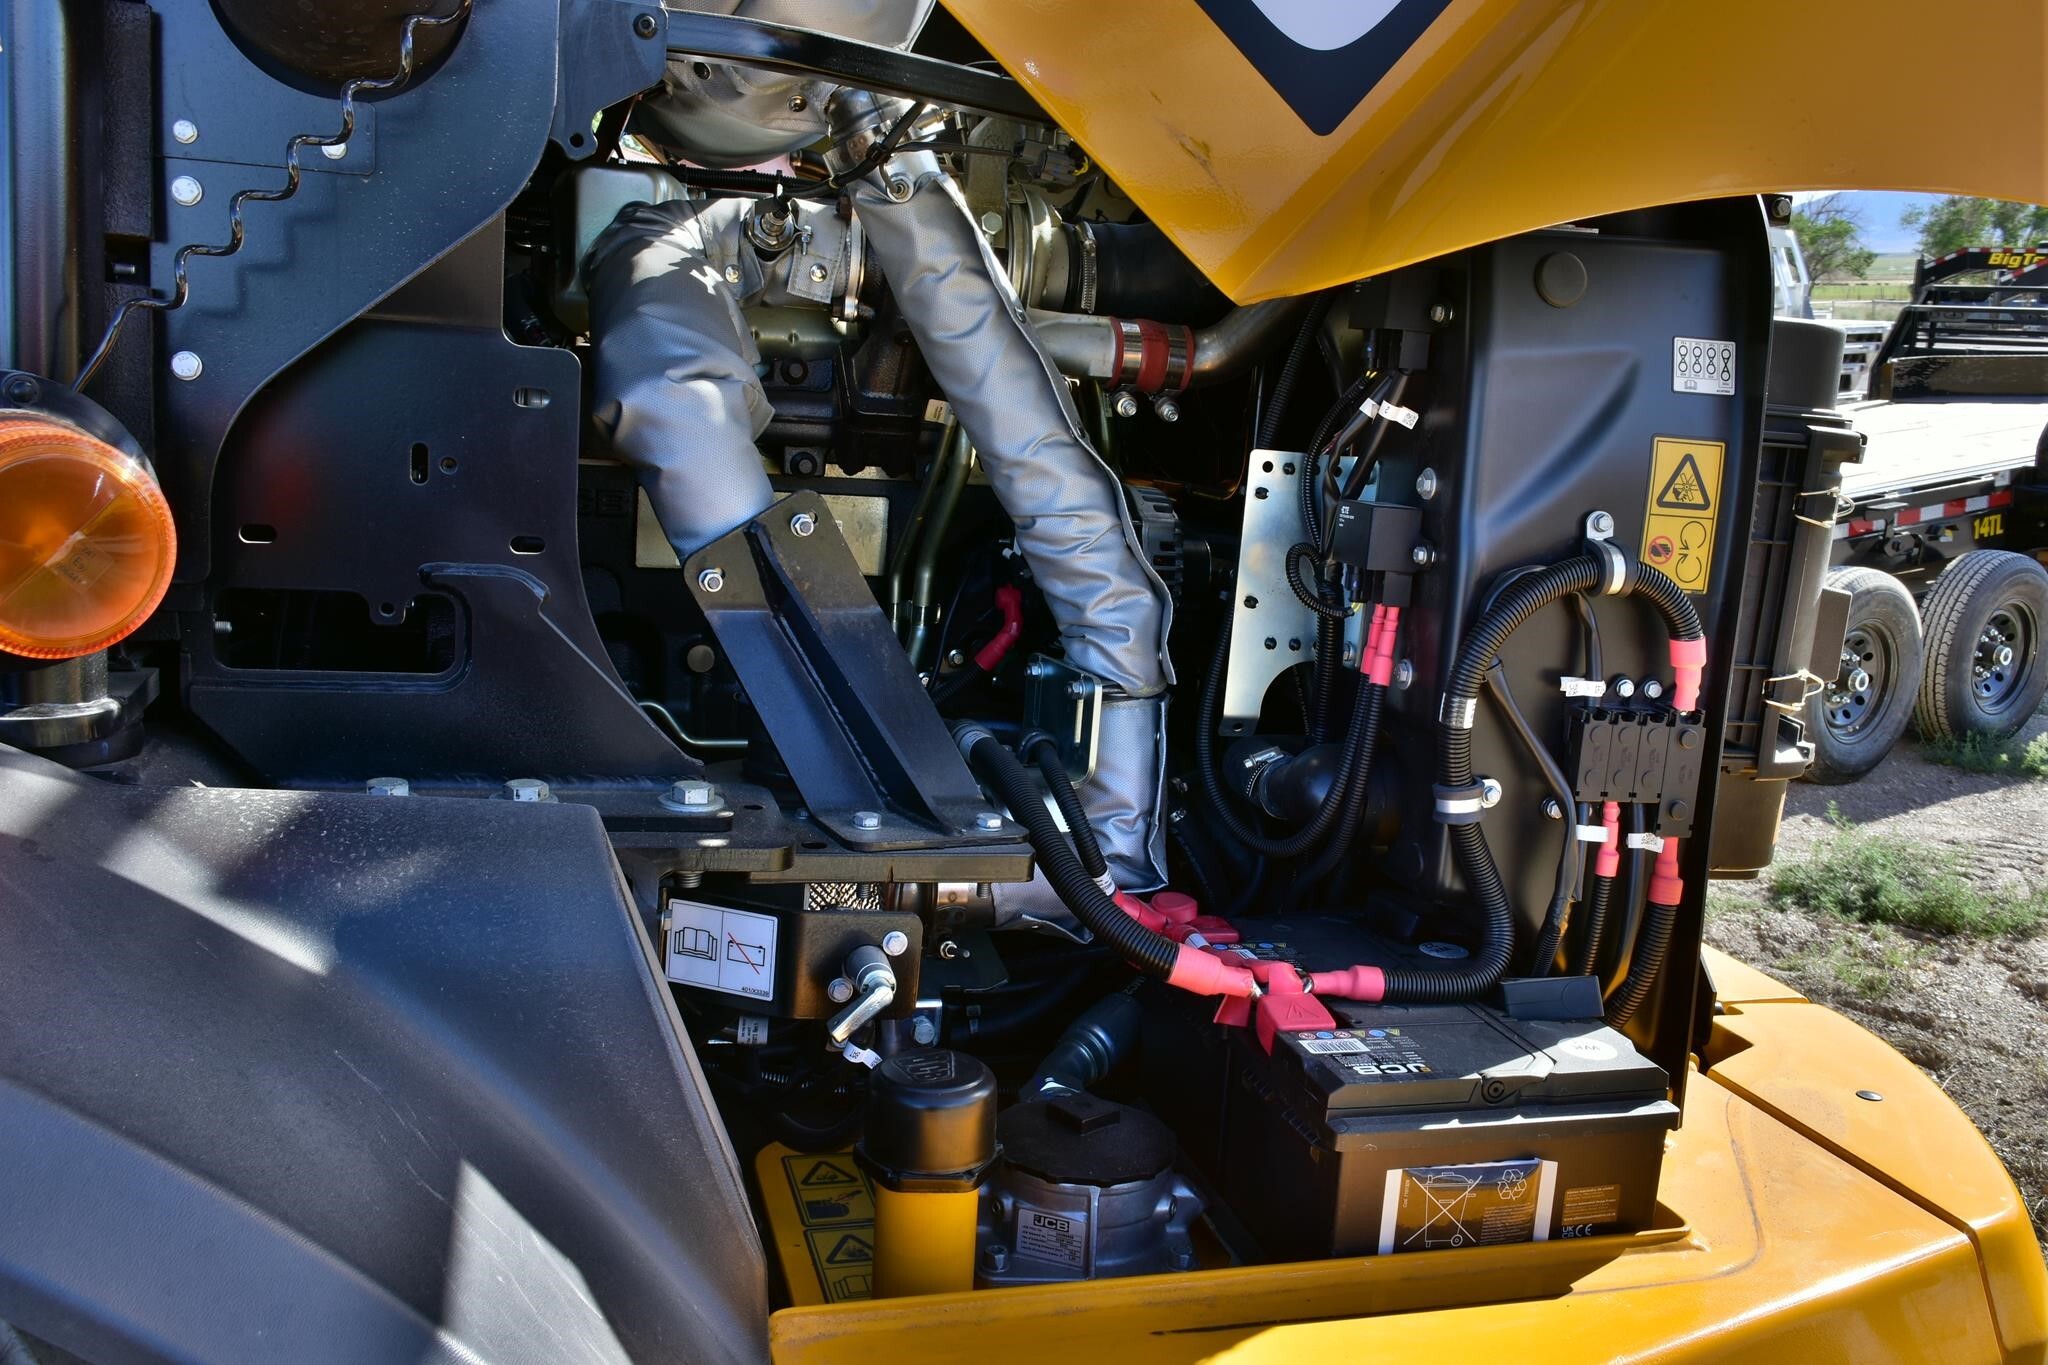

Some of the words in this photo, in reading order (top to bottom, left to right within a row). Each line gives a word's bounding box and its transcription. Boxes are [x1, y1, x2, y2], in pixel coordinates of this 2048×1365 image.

[1973, 514, 2004, 540] 14TL
[1353, 1063, 1428, 1076] JCB
[1034, 1215, 1069, 1233] JCB
